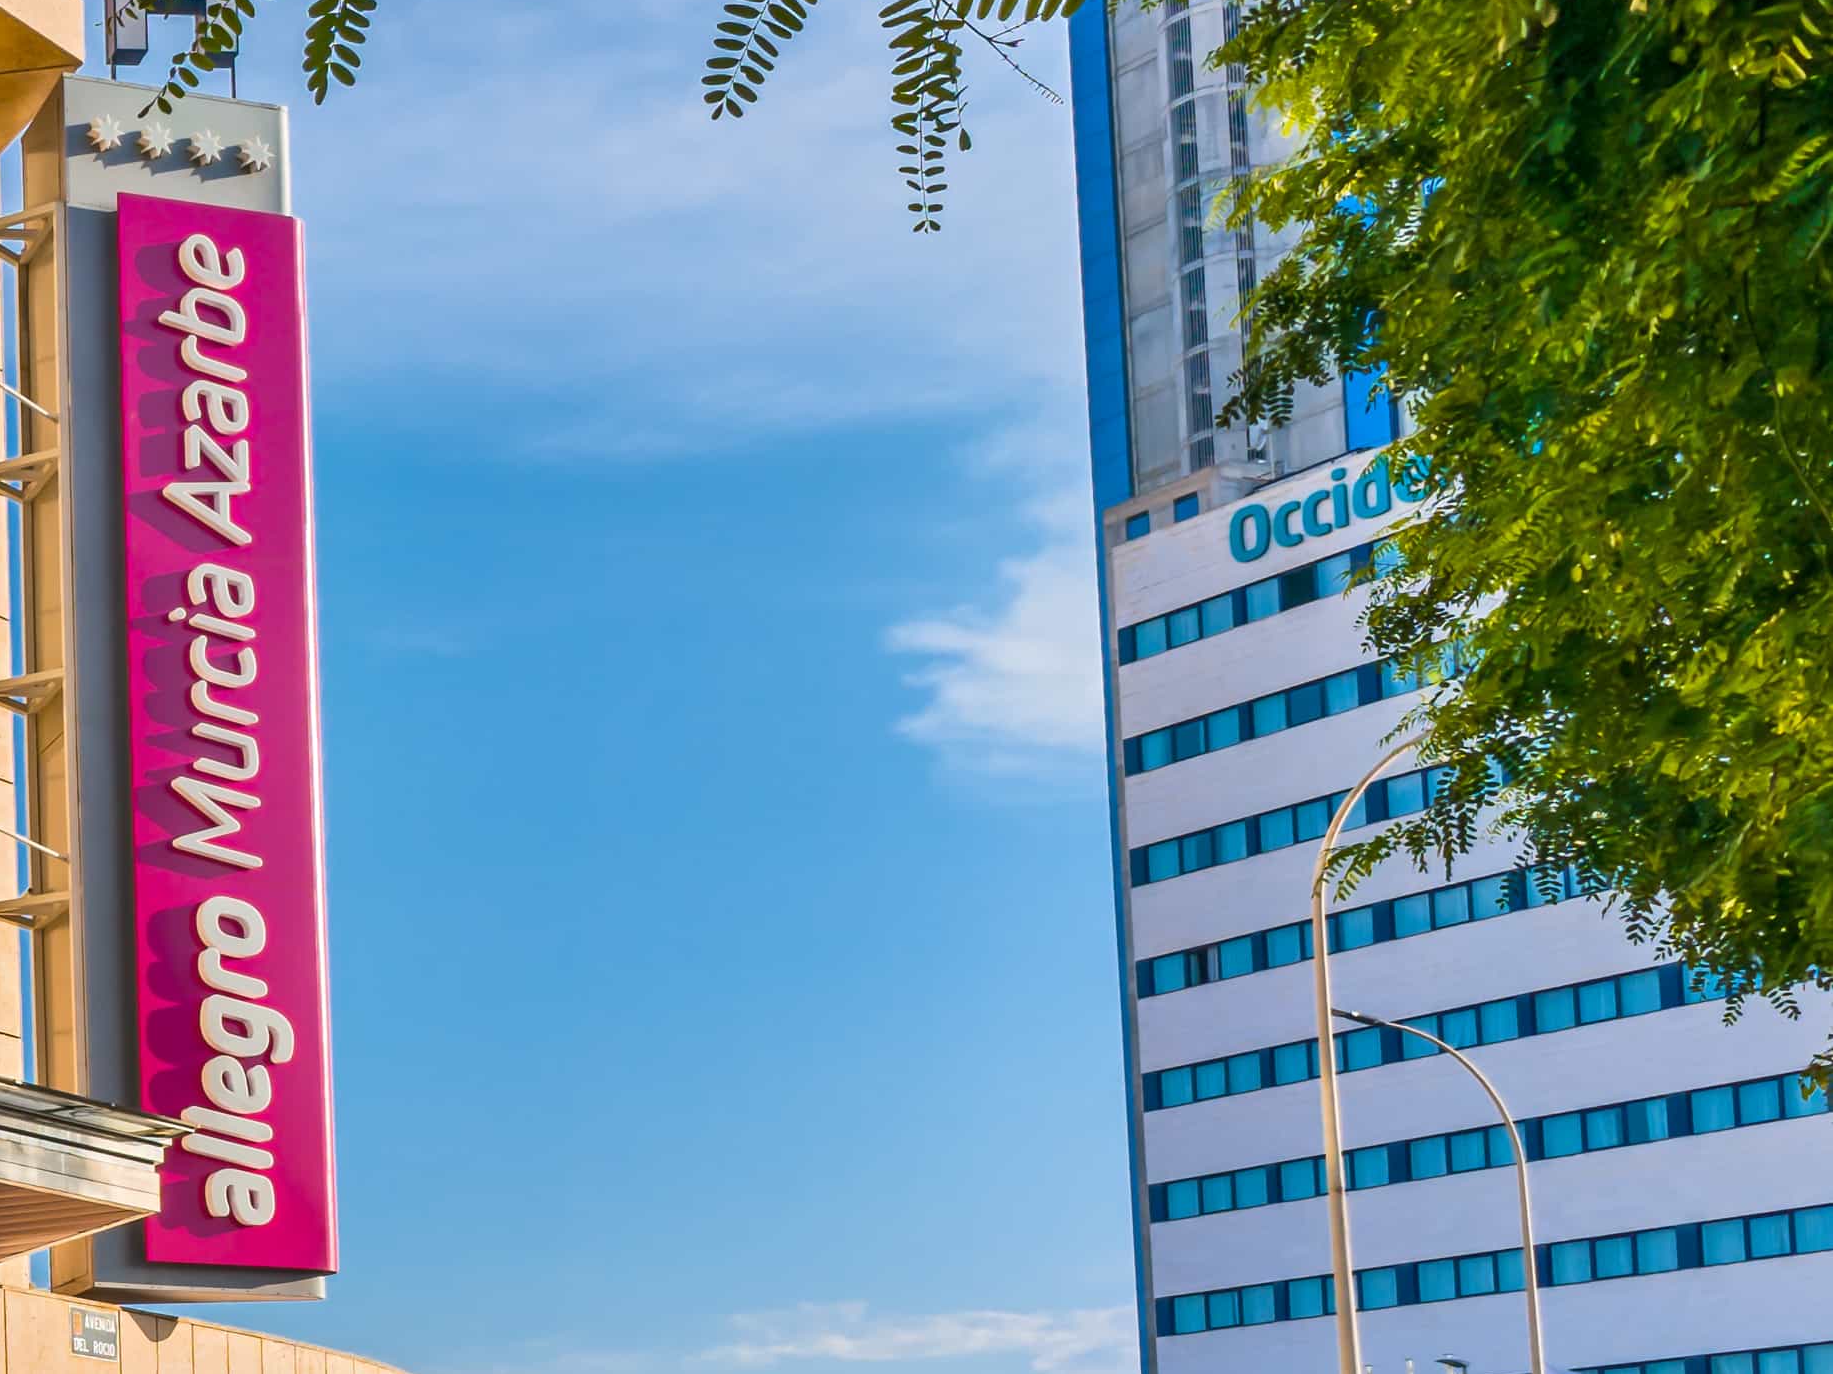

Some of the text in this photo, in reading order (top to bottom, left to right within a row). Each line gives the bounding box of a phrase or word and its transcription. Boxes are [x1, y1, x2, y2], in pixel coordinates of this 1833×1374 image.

[158, 234, 294, 1227] allegro Murcia Azarbe
[85, 1313, 116, 1333] AVENIDA
[73, 1337, 90, 1353] DEL
